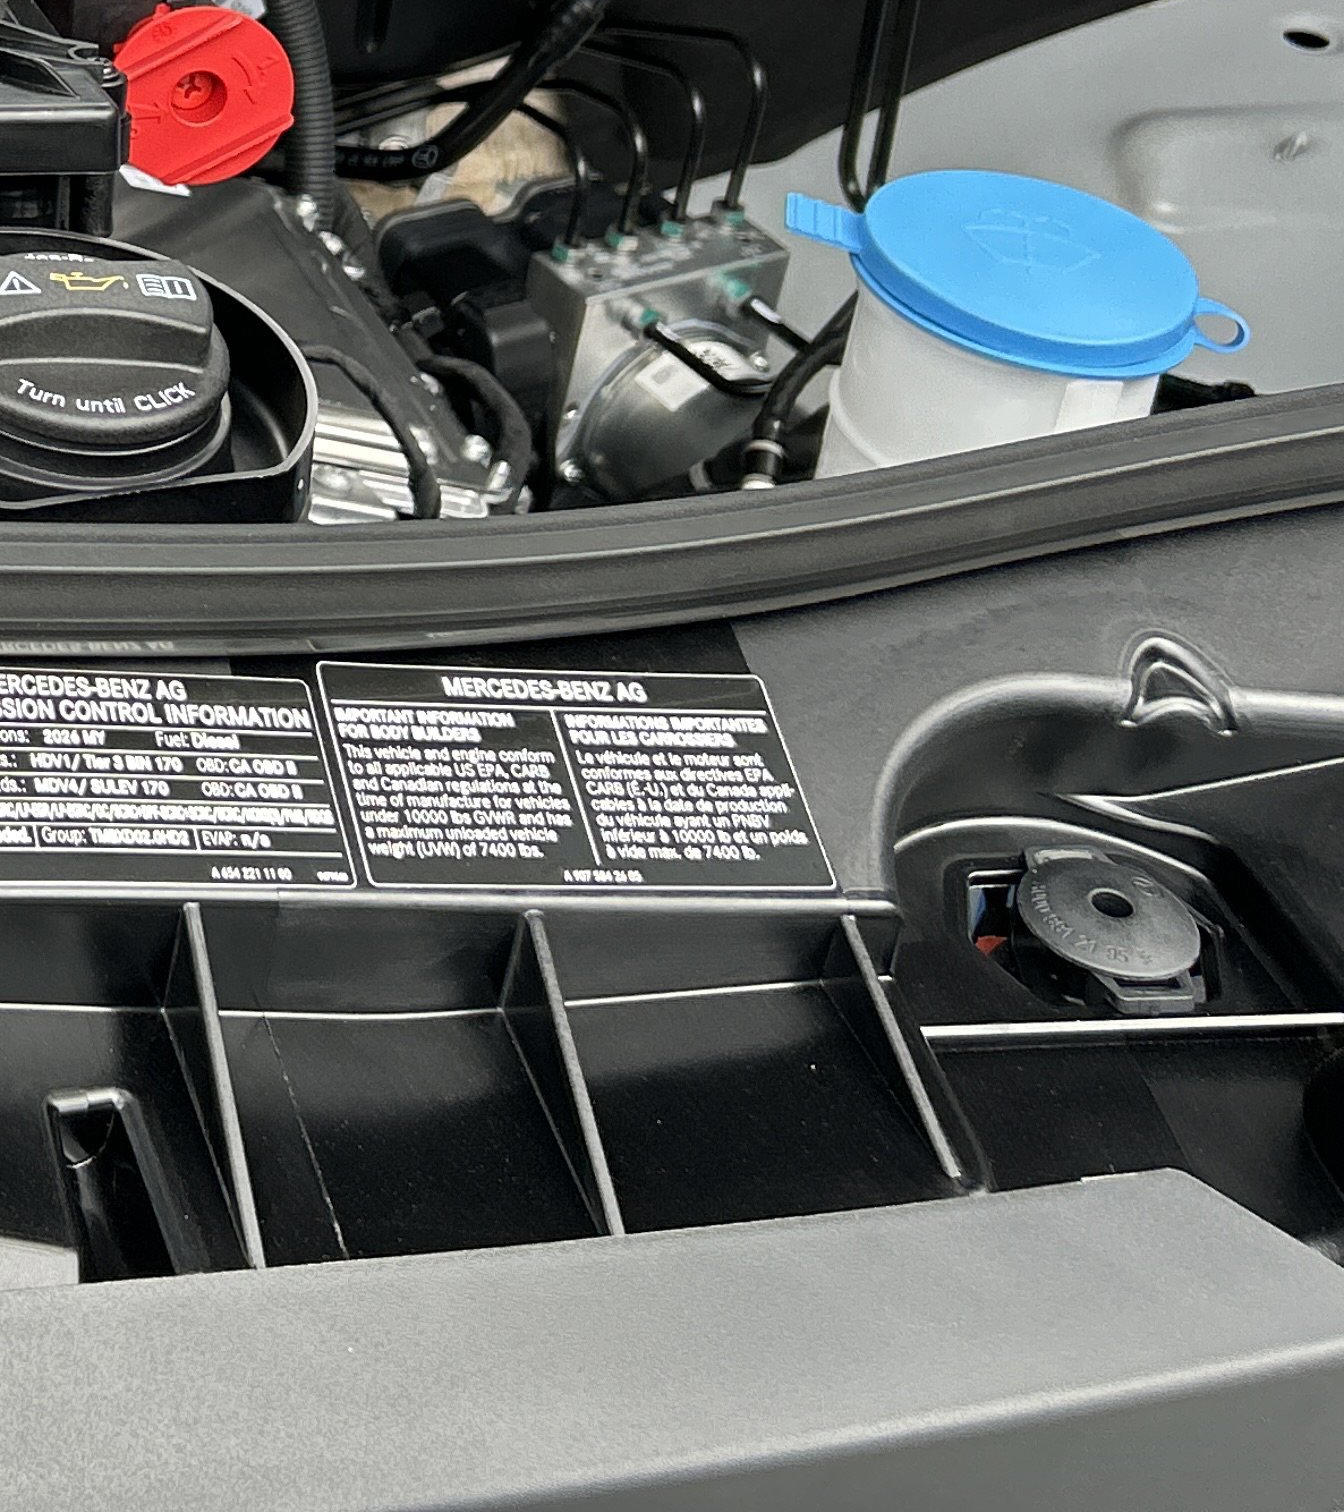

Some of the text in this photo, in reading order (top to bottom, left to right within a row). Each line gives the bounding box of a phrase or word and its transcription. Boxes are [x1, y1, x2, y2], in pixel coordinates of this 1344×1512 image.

[16, 378, 196, 414] Turn until CLICK
[155, 679, 187, 701] AG
[441, 676, 647, 703] MERCEDES-BENZ AG
[58, 699, 162, 724] CONTROL
[163, 703, 311, 728] INFORMATION
[333, 706, 514, 727] IMPORTANT INFORMATION
[563, 713, 767, 733] INFORMATIONS IMPORTANTES
[81, 729, 105, 745] MY
[154, 730, 190, 748] Fuel:
[189, 732, 240, 750] Diesel
[337, 723, 481, 742] FOR BODY BUILDERS
[568, 728, 735, 747] POUR LES CARROSSIERS
[341, 742, 555, 764] This vehicle and engine conform
[574, 749, 765, 769] Le véhicule moteur sont
[346, 759, 550, 779] to all applicable US EPA, CARB
[580, 765, 652, 781] conformes
[653, 768, 679, 781] aux
[679, 767, 743, 782] directives
[351, 776, 562, 795] and Canadian regulations at the
[585, 780, 625, 796] CARB
[685, 782, 705, 797] du
[705, 782, 757, 798] Canada
[758, 783, 795, 800] appli-
[355, 792, 570, 810] time of manufacture for vehicles
[590, 796, 787, 815] cables date de production
[359, 808, 573, 827] under 10000 lbs GVWR and has
[595, 812, 616, 829] du
[615, 812, 671, 829] véhicule
[673, 813, 712, 830] ayant
[711, 813, 731, 830] un
[40, 826, 87, 848] Group:
[200, 829, 238, 846] EVAP:
[239, 830, 271, 849] n/a
[375, 825, 558, 844] maximum unloaded vehicle
[599, 827, 808, 847] inférieur 10000 lb un poids
[367, 841, 544, 859] weight (UVW) of 7400 lbs.
[616, 843, 760, 860] vide max. de 7400 lb.
